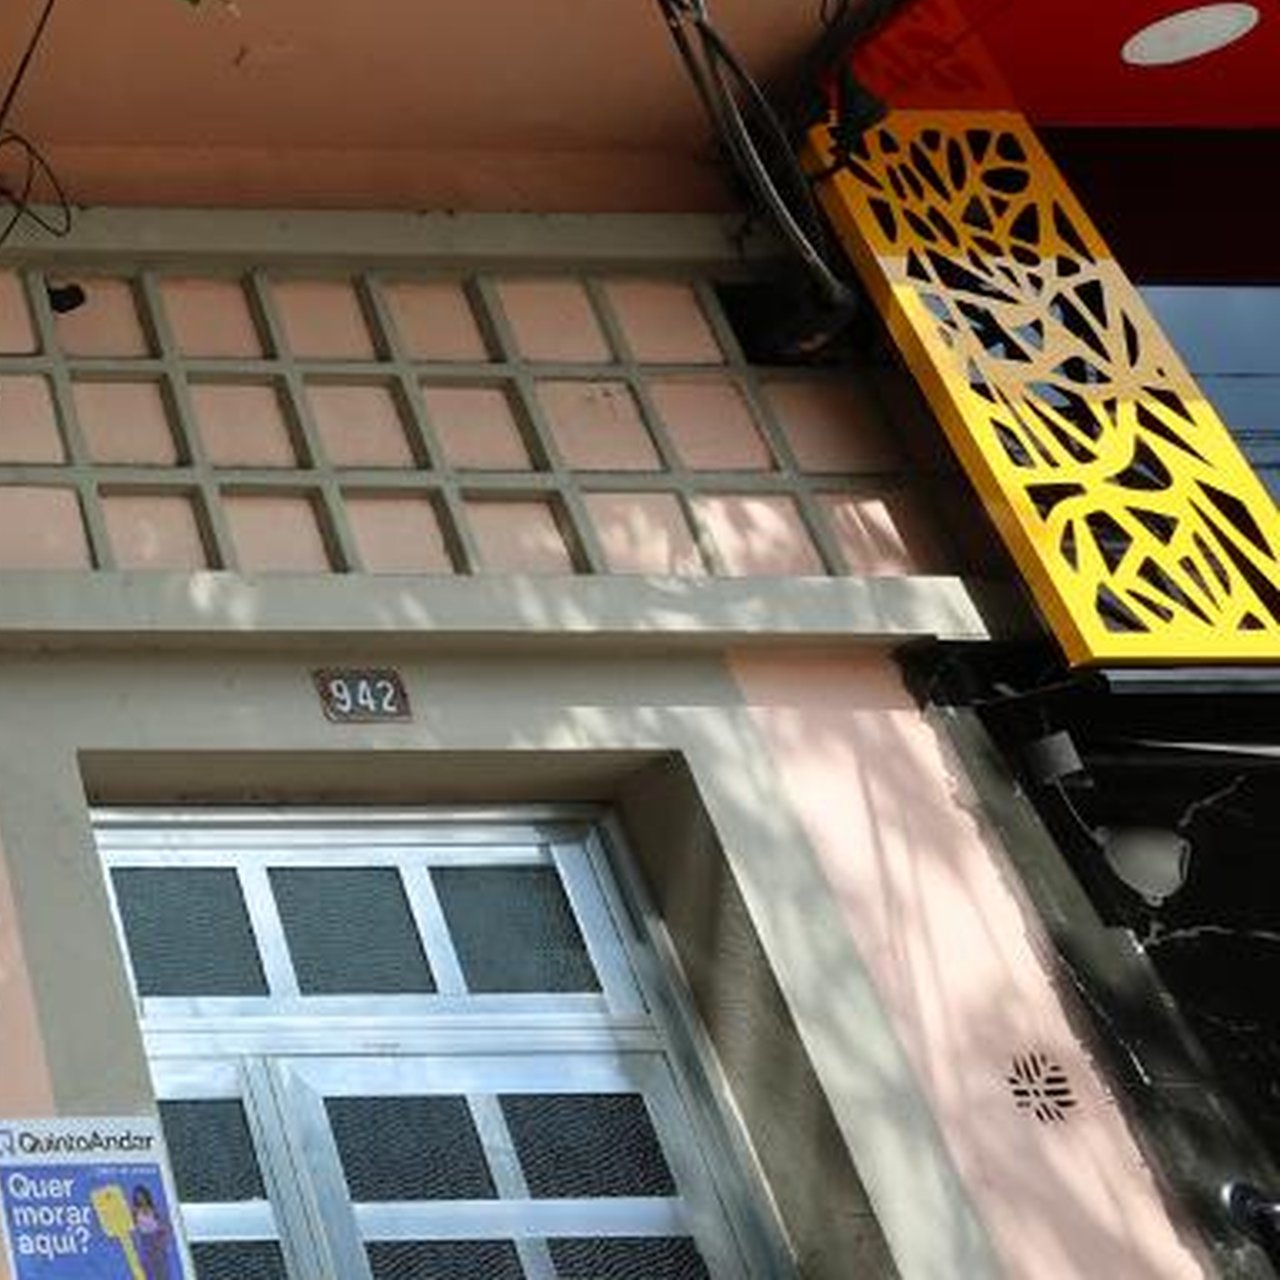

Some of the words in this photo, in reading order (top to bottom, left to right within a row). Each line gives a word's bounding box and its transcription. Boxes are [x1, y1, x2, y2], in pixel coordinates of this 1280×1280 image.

[329, 679, 397, 712] 942
[19, 1131, 155, 1154] QuintoAndar
[8, 1172, 75, 1199] Quer
[12, 1204, 92, 1227] morar
[17, 1225, 92, 1261] aqui?
